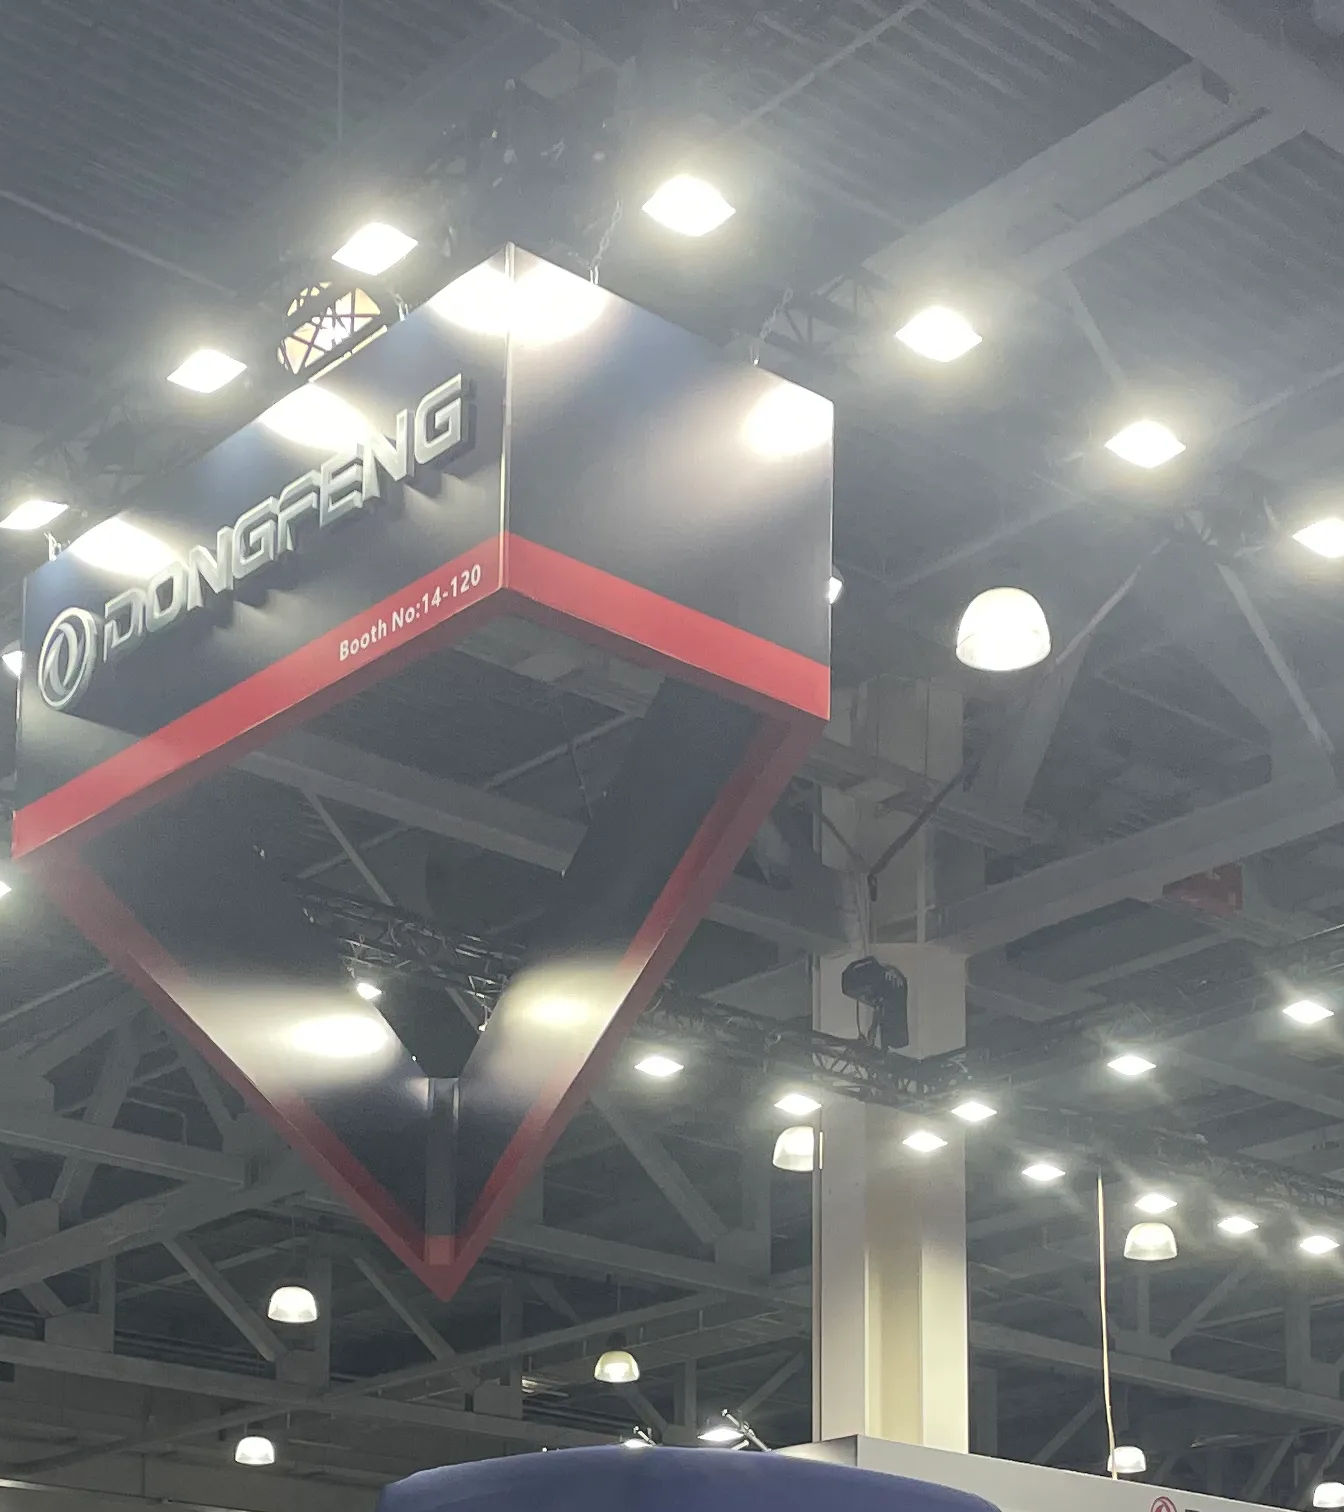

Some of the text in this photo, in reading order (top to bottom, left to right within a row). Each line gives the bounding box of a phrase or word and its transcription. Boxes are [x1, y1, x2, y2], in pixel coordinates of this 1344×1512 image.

[103, 373, 464, 662] DONGFENG
[339, 563, 482, 662] Booth No:14-120
